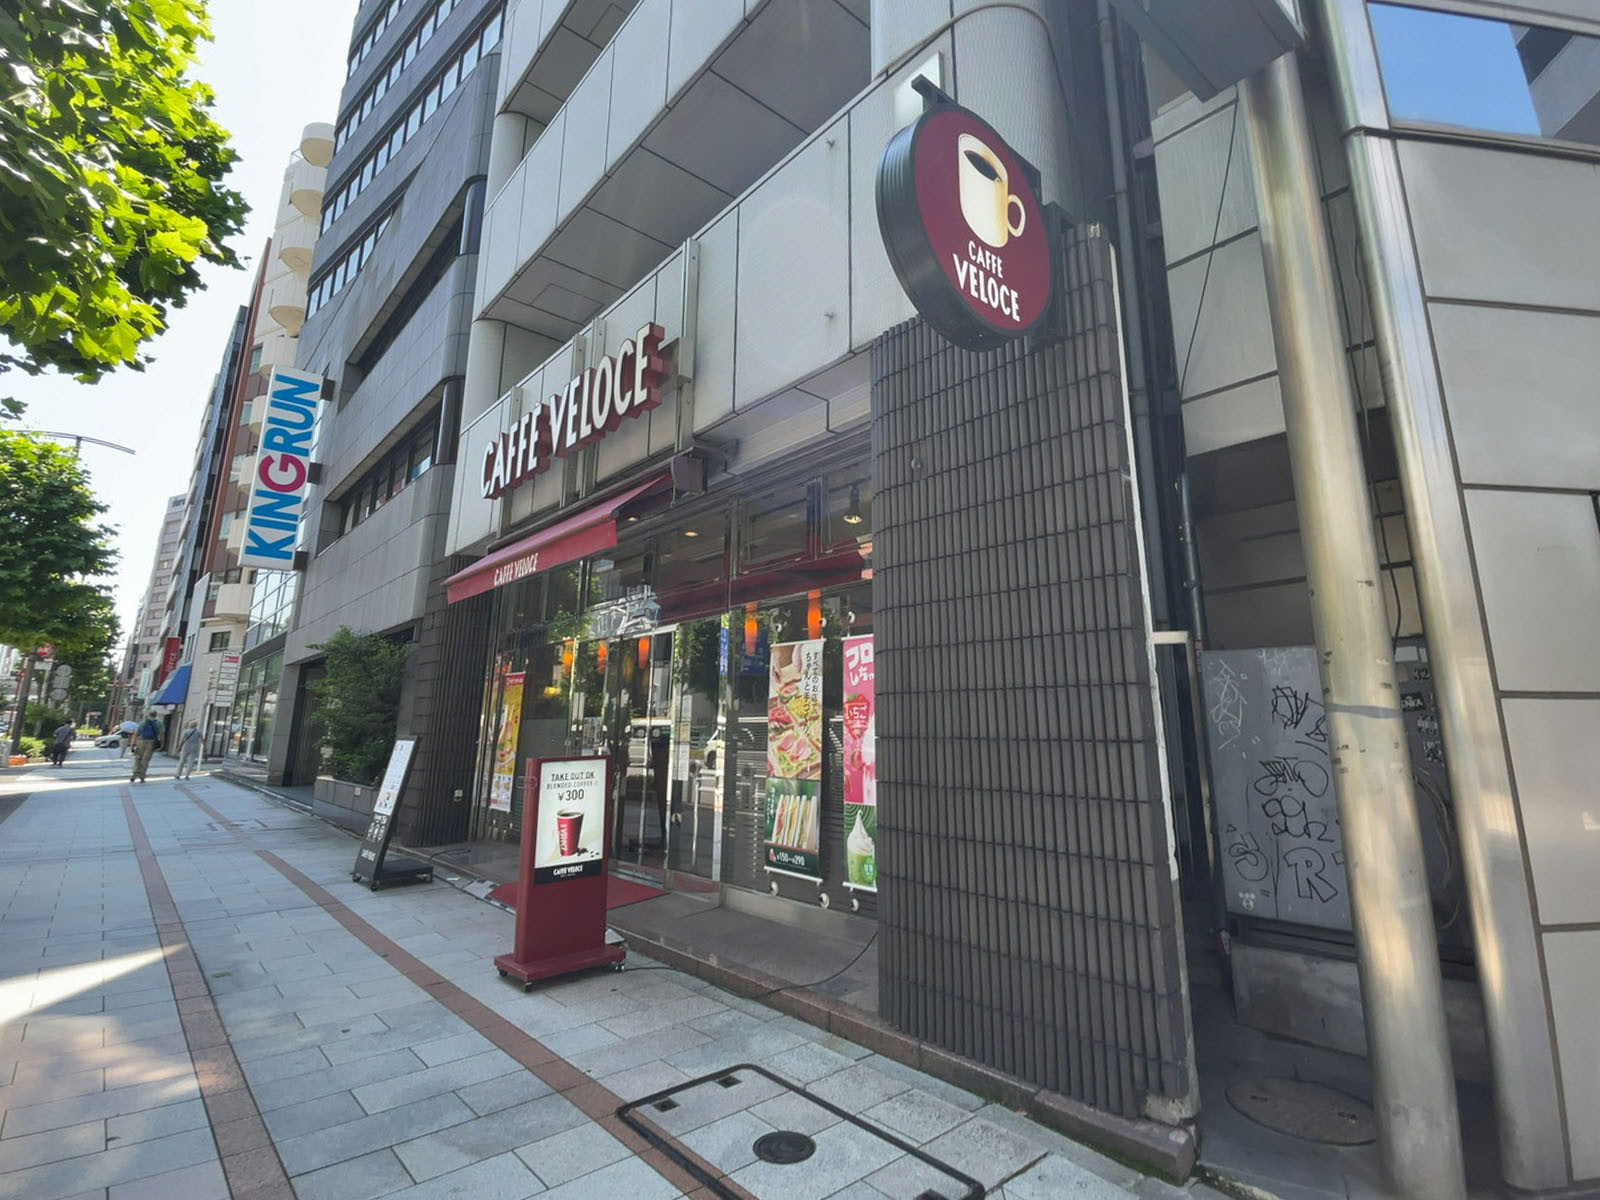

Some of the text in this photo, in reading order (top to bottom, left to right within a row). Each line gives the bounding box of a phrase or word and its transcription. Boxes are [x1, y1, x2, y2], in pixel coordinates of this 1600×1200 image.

[952, 252, 1020, 322] VELOCE
[549, 322, 658, 457] VELOCE
[244, 373, 320, 560] KINGRUN
[514, 552, 539, 579] VELOCE
[551, 771, 595, 782] TAKE OUT OK
